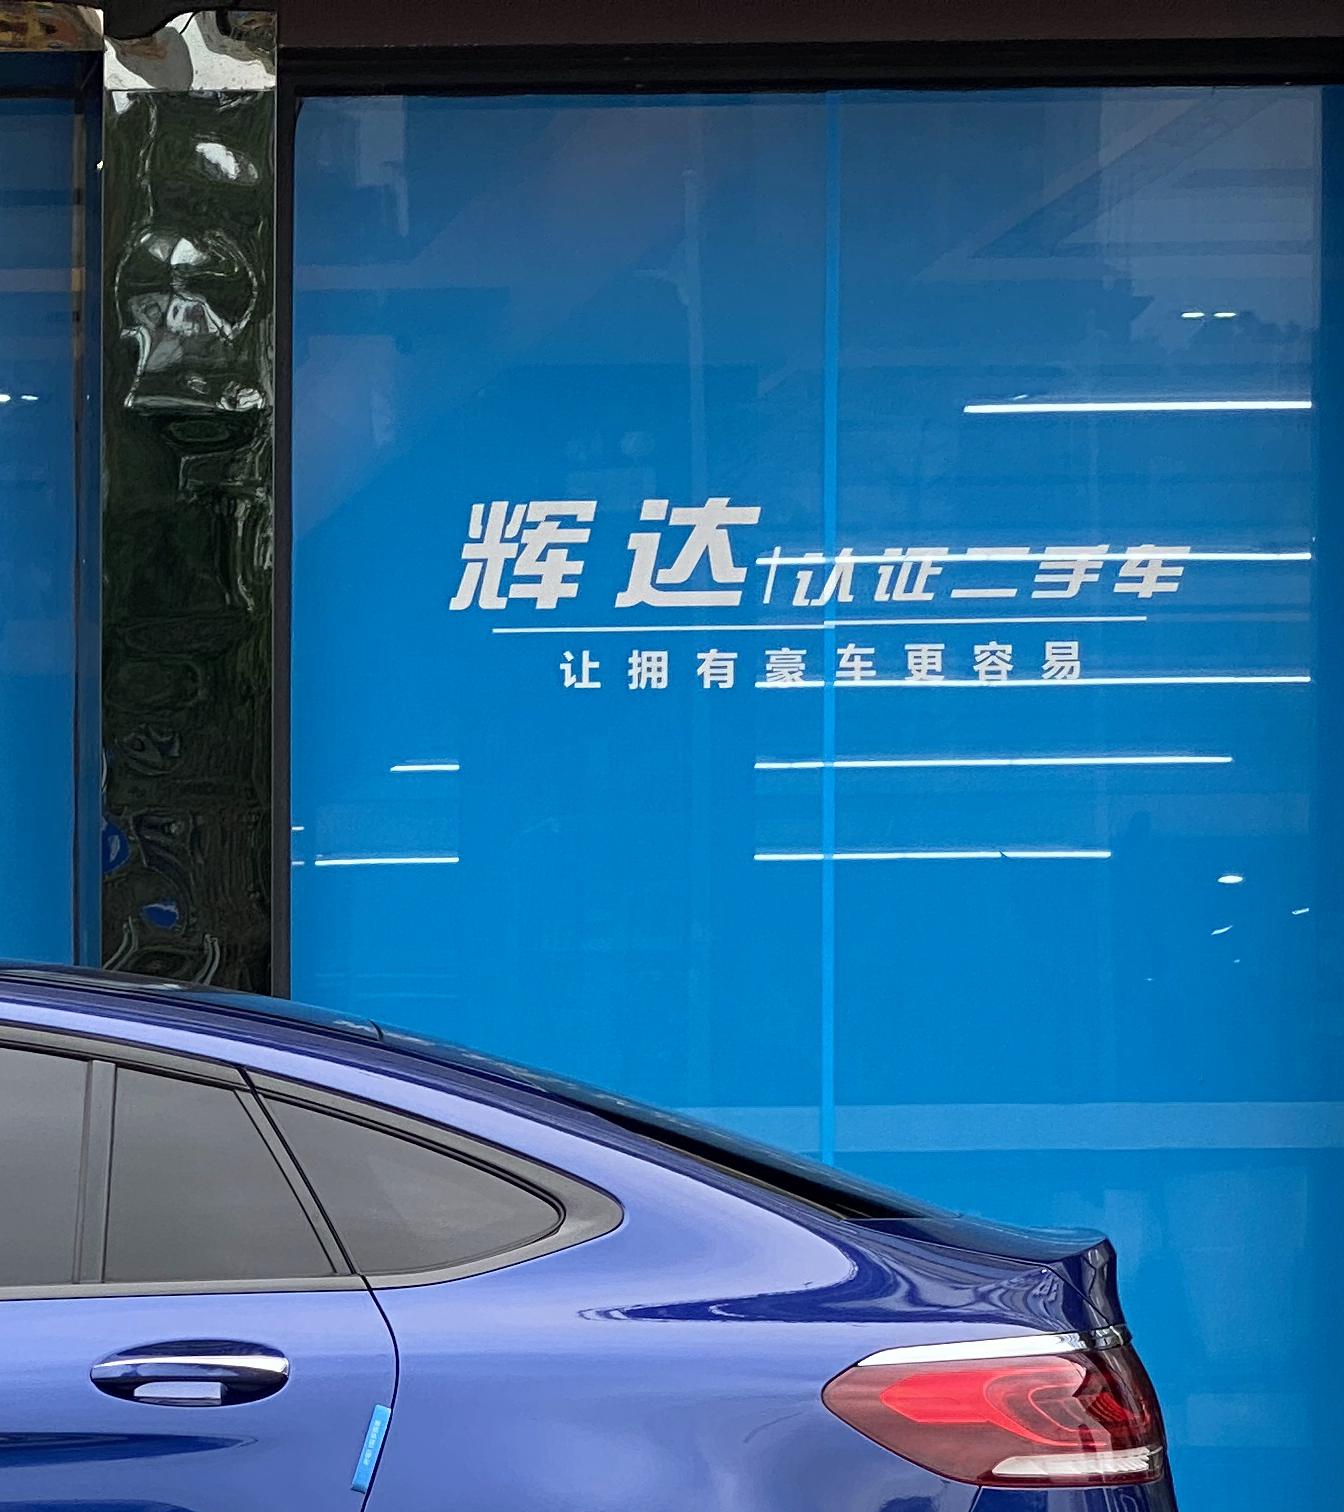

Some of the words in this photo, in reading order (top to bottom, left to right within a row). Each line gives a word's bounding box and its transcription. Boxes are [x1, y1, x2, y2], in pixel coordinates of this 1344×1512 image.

[559, 640, 1082, 690] 让拥有豪车更容易
